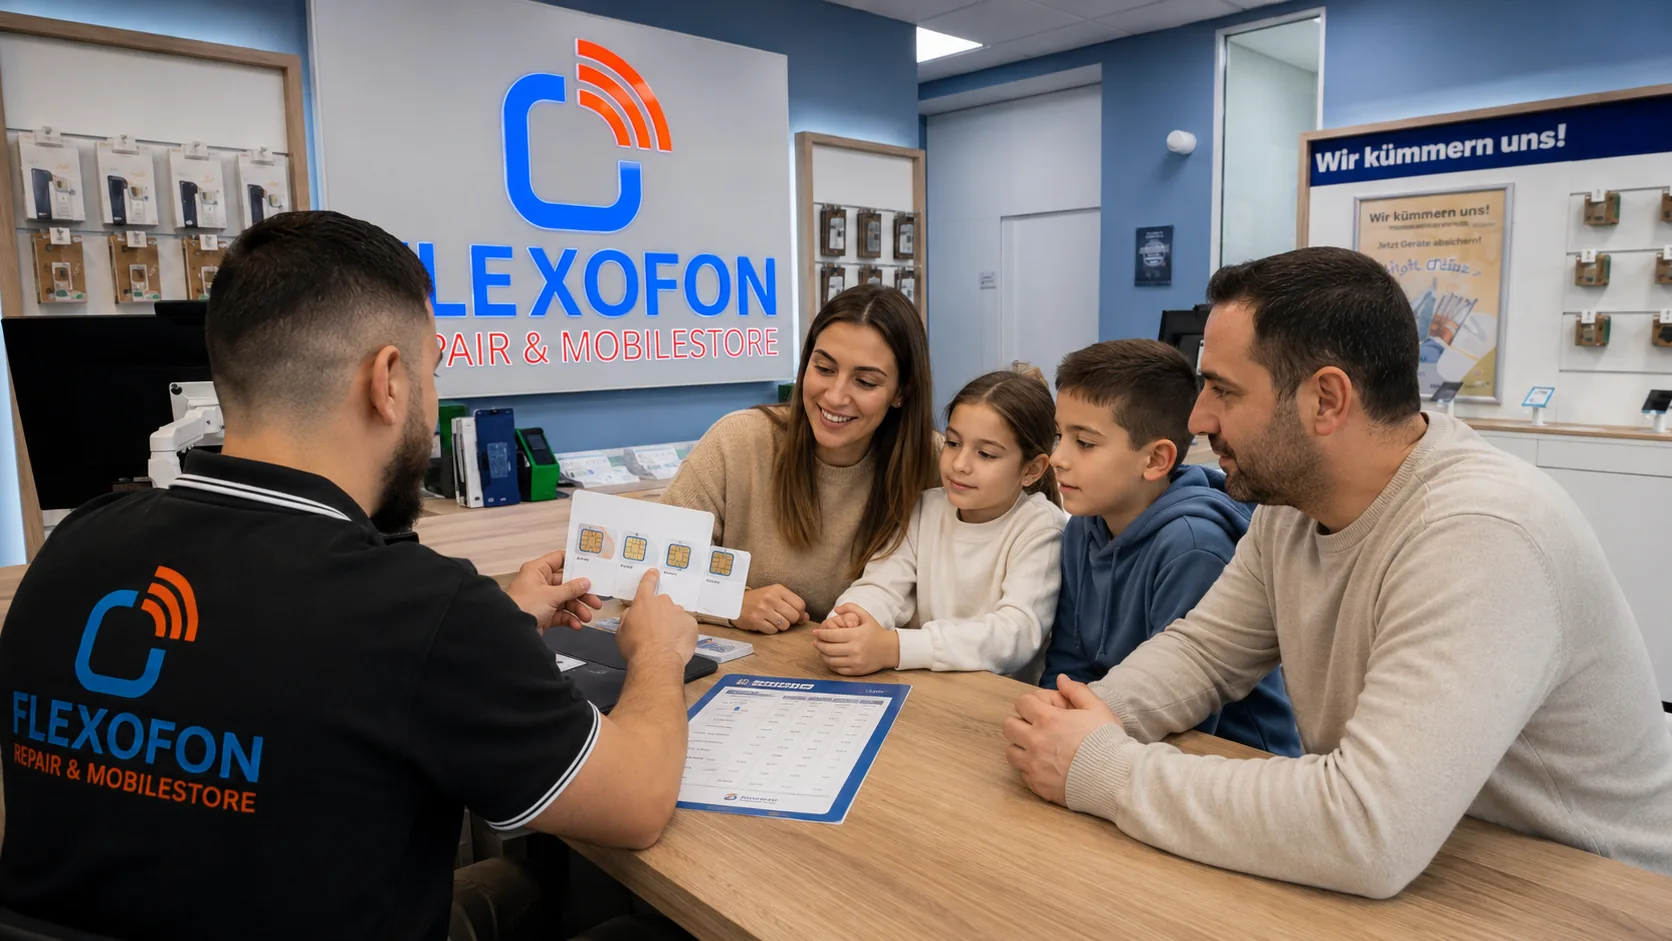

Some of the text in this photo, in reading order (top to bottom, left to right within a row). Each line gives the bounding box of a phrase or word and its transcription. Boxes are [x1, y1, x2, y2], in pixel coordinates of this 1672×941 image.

[1315, 123, 1567, 173] Wir kümmern uns!
[1369, 204, 1490, 223] Wir kümmern uns!
[402, 241, 777, 318] LEXOFON
[523, 330, 550, 365] &
[561, 328, 779, 363] MOBILESTORE
[13, 690, 264, 783] FLEXOFON
[13, 743, 257, 814] REPAIR & MOBILESTORE
